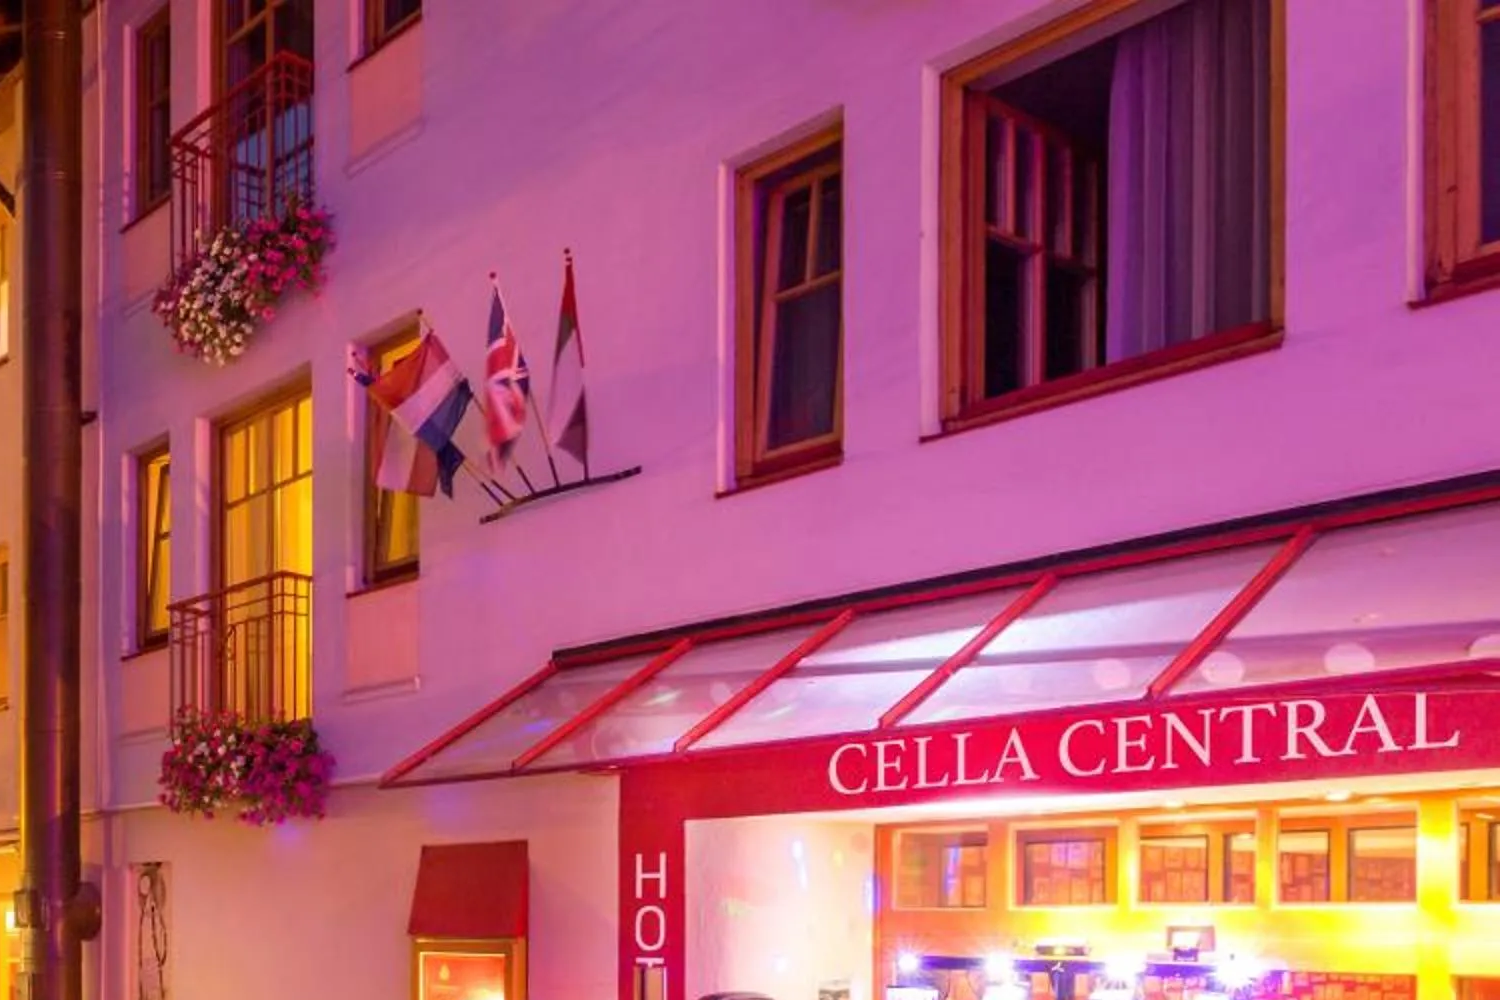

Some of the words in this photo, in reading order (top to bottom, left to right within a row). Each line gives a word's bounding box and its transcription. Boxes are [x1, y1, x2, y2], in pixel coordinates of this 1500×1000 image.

[828, 727, 1041, 795] CELLA
[1058, 692, 1461, 777] CENTRAL
[635, 852, 667, 967] HO
